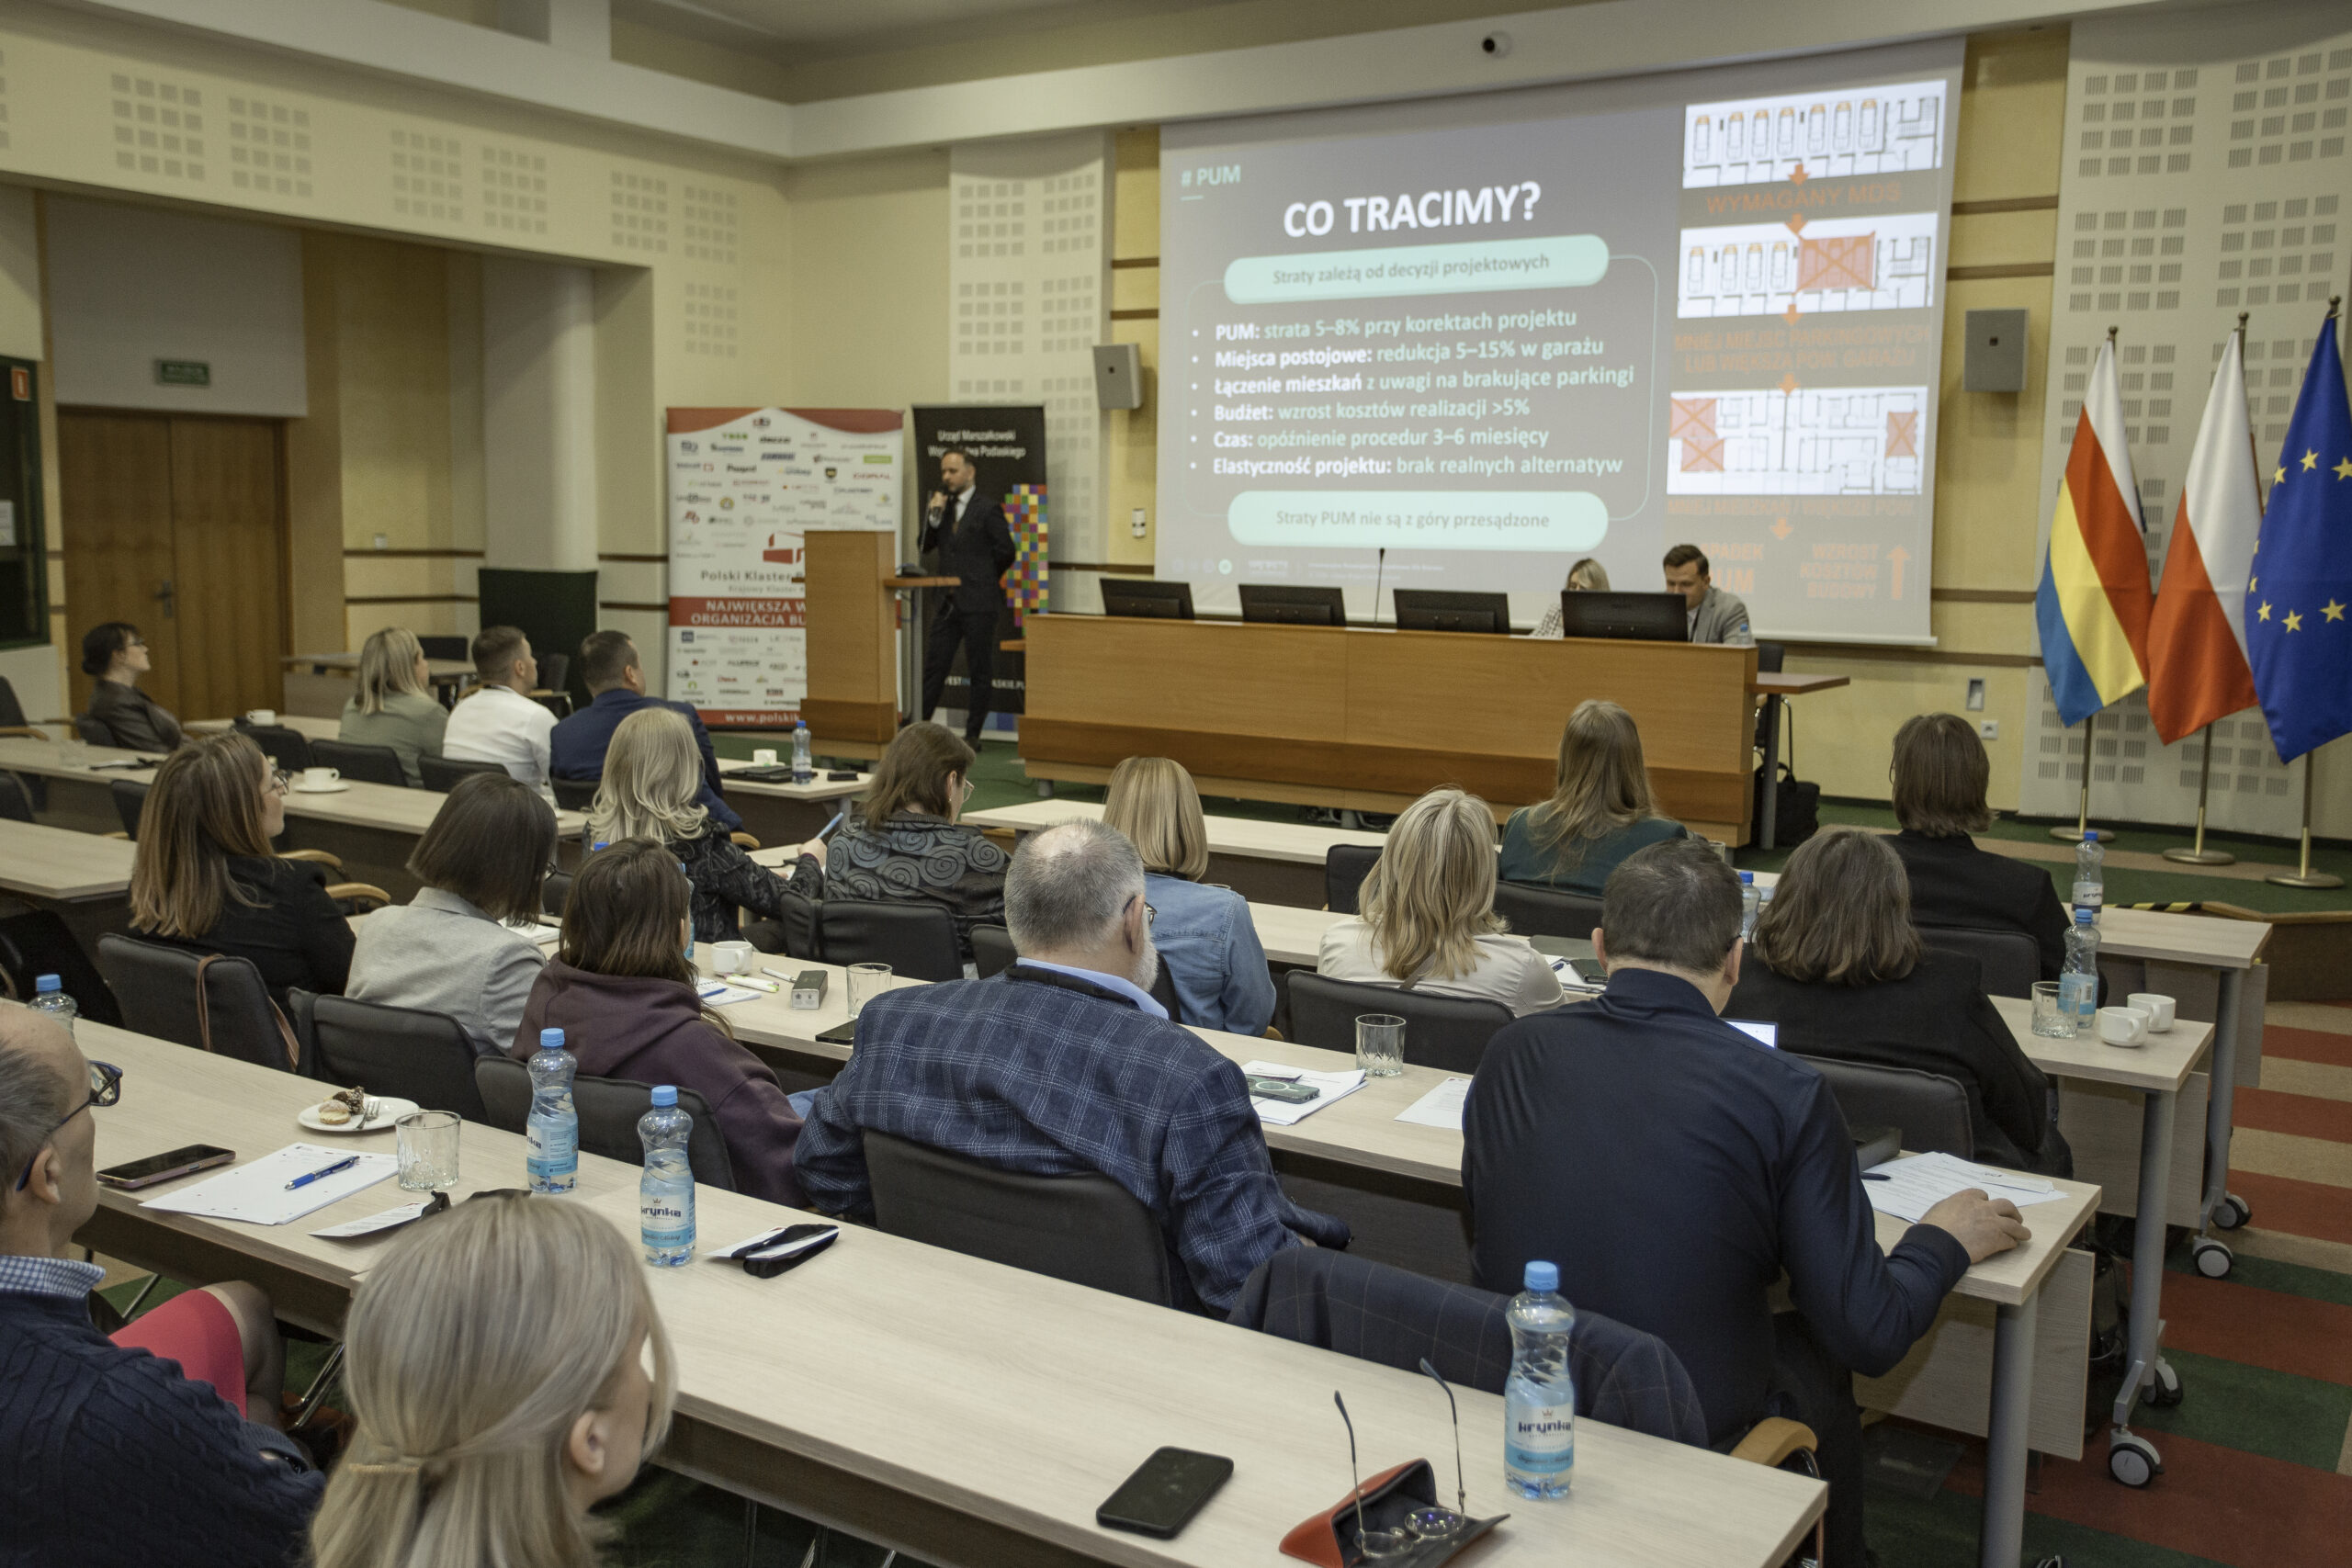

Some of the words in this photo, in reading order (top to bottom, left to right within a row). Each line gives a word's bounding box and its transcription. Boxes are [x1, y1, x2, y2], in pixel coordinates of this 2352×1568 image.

[1181, 170, 1192, 186] #
[1197, 165, 1240, 185] PUM
[1284, 200, 1334, 237] CO
[1344, 181, 1542, 232] TRACIMY?
[1707, 188, 1840, 213] WYMAGANY
[1849, 183, 1901, 202] MDS
[1272, 267, 1315, 287] Straty
[1318, 265, 1361, 283] zależą
[1366, 263, 1384, 278] od
[1388, 259, 1439, 280] decyzji
[1443, 254, 1550, 277] projektowych
[1216, 323, 1260, 341] PUM:
[1264, 322, 1310, 338] strata
[1365, 321, 1401, 339] przy
[1406, 311, 1492, 333] korektach
[1498, 310, 1577, 333] projektu
[1216, 350, 1275, 370] Miejsca
[1280, 347, 1372, 369] postojowe:
[1377, 344, 1451, 365] redukcja
[1521, 344, 1538, 358] w
[1543, 336, 1603, 360] garażu
[1215, 377, 1282, 398] Łączenie
[1286, 373, 1362, 392] mieszkań
[1366, 378, 1375, 389] z
[1380, 373, 1430, 393] uwagi
[1436, 374, 1457, 388] na
[1463, 369, 1552, 391] brakujące
[1556, 366, 1634, 389] parkingi
[1215, 404, 1274, 422] Budżet:
[1278, 404, 1332, 420] wzrost
[1337, 400, 1406, 419] kosztów
[1409, 399, 1487, 421] realizacji
[1492, 398, 1531, 416] >5%
[1214, 431, 1254, 448] Czas:
[1258, 429, 1347, 450] opóźnienie
[1351, 428, 1429, 450] procedur
[1470, 425, 1549, 449] miesięcy
[1213, 456, 1312, 478] Elastyczność
[1316, 456, 1393, 479] projektu:
[1396, 457, 1435, 474] brak
[1440, 456, 1515, 478] realnych
[1521, 456, 1623, 478] alternatyw
[1276, 511, 1317, 527] Straty
[1321, 510, 1356, 525] PUM
[1361, 511, 1382, 525] nie
[1385, 513, 1402, 529] są
[1406, 514, 1413, 526] z
[1417, 511, 1450, 530] góry
[1454, 510, 1550, 530] przesądzone
[701, 570, 741, 581] Polski
[745, 570, 790, 581] Klaster
[691, 613, 785, 625] ORGANIZACJA
[707, 601, 790, 615] NAJWIĘKSZA
[641, 1205, 682, 1217] krynka
[1519, 1419, 1571, 1433] krynka
